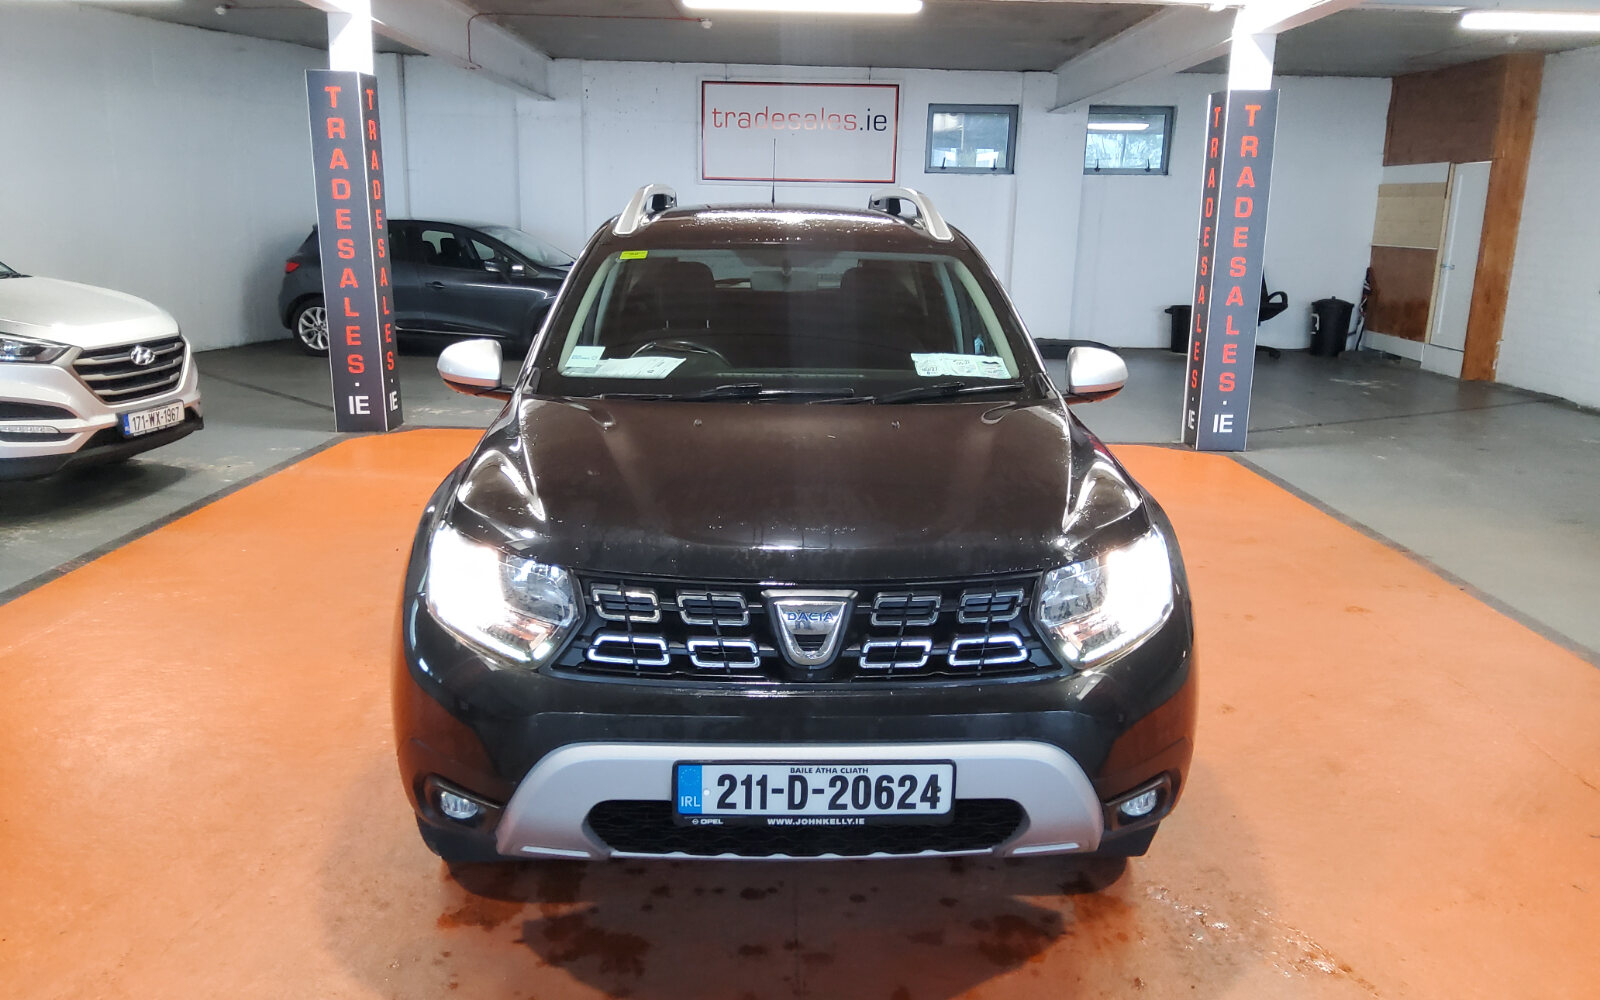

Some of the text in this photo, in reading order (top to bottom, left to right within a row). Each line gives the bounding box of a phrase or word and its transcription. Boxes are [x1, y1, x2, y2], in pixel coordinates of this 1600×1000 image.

[712, 106, 887, 132] tradesales.ie
[132, 406, 180, 431] 171-WX-1967
[786, 611, 834, 621] DACIA
[680, 795, 701, 808] IRL
[716, 773, 940, 810] 211-D-20624
